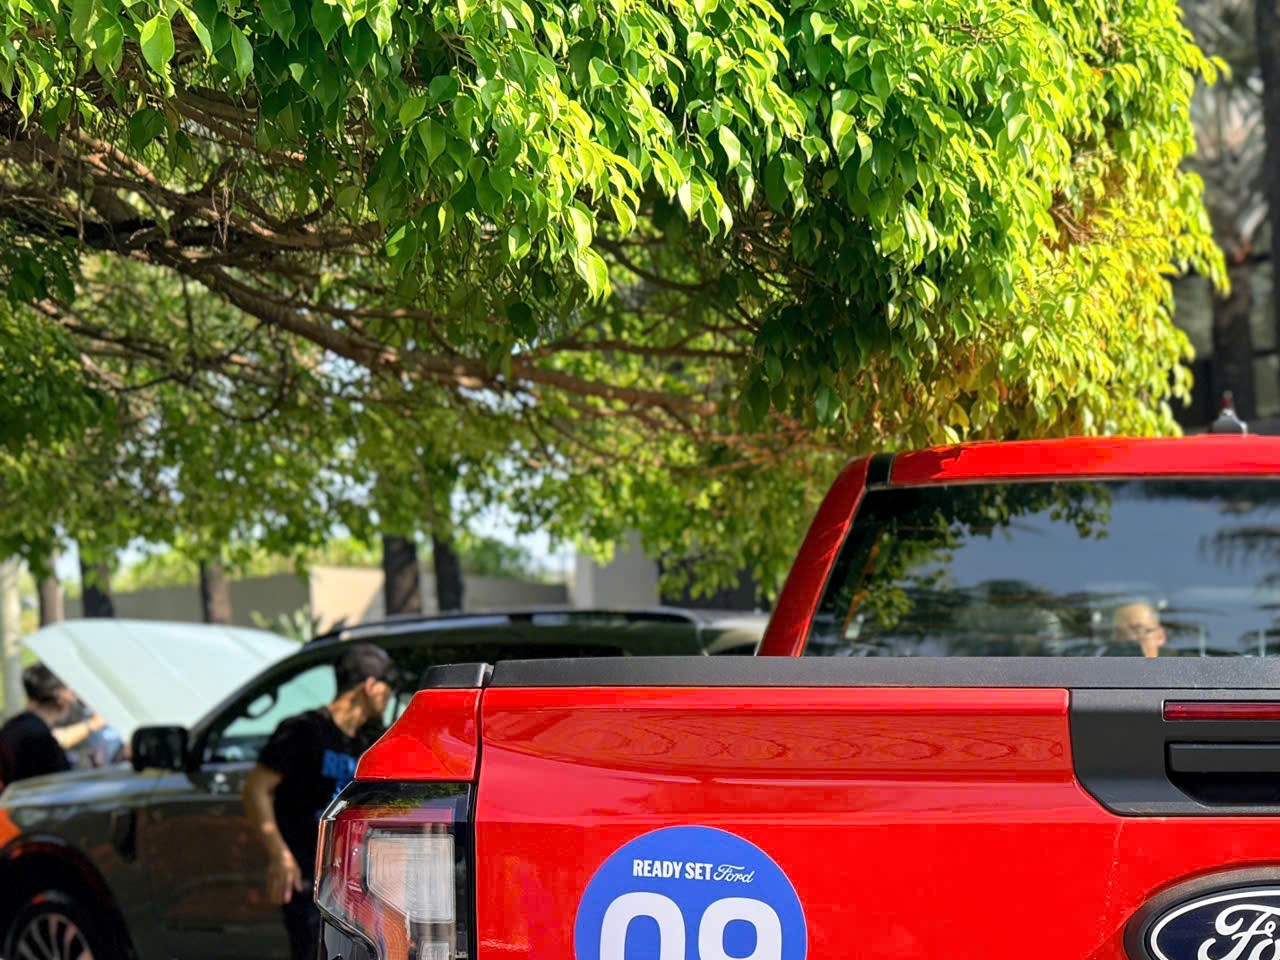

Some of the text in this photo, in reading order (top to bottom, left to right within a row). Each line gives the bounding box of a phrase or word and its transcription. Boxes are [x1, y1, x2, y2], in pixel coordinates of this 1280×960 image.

[632, 859, 755, 884] READY SET Ford
